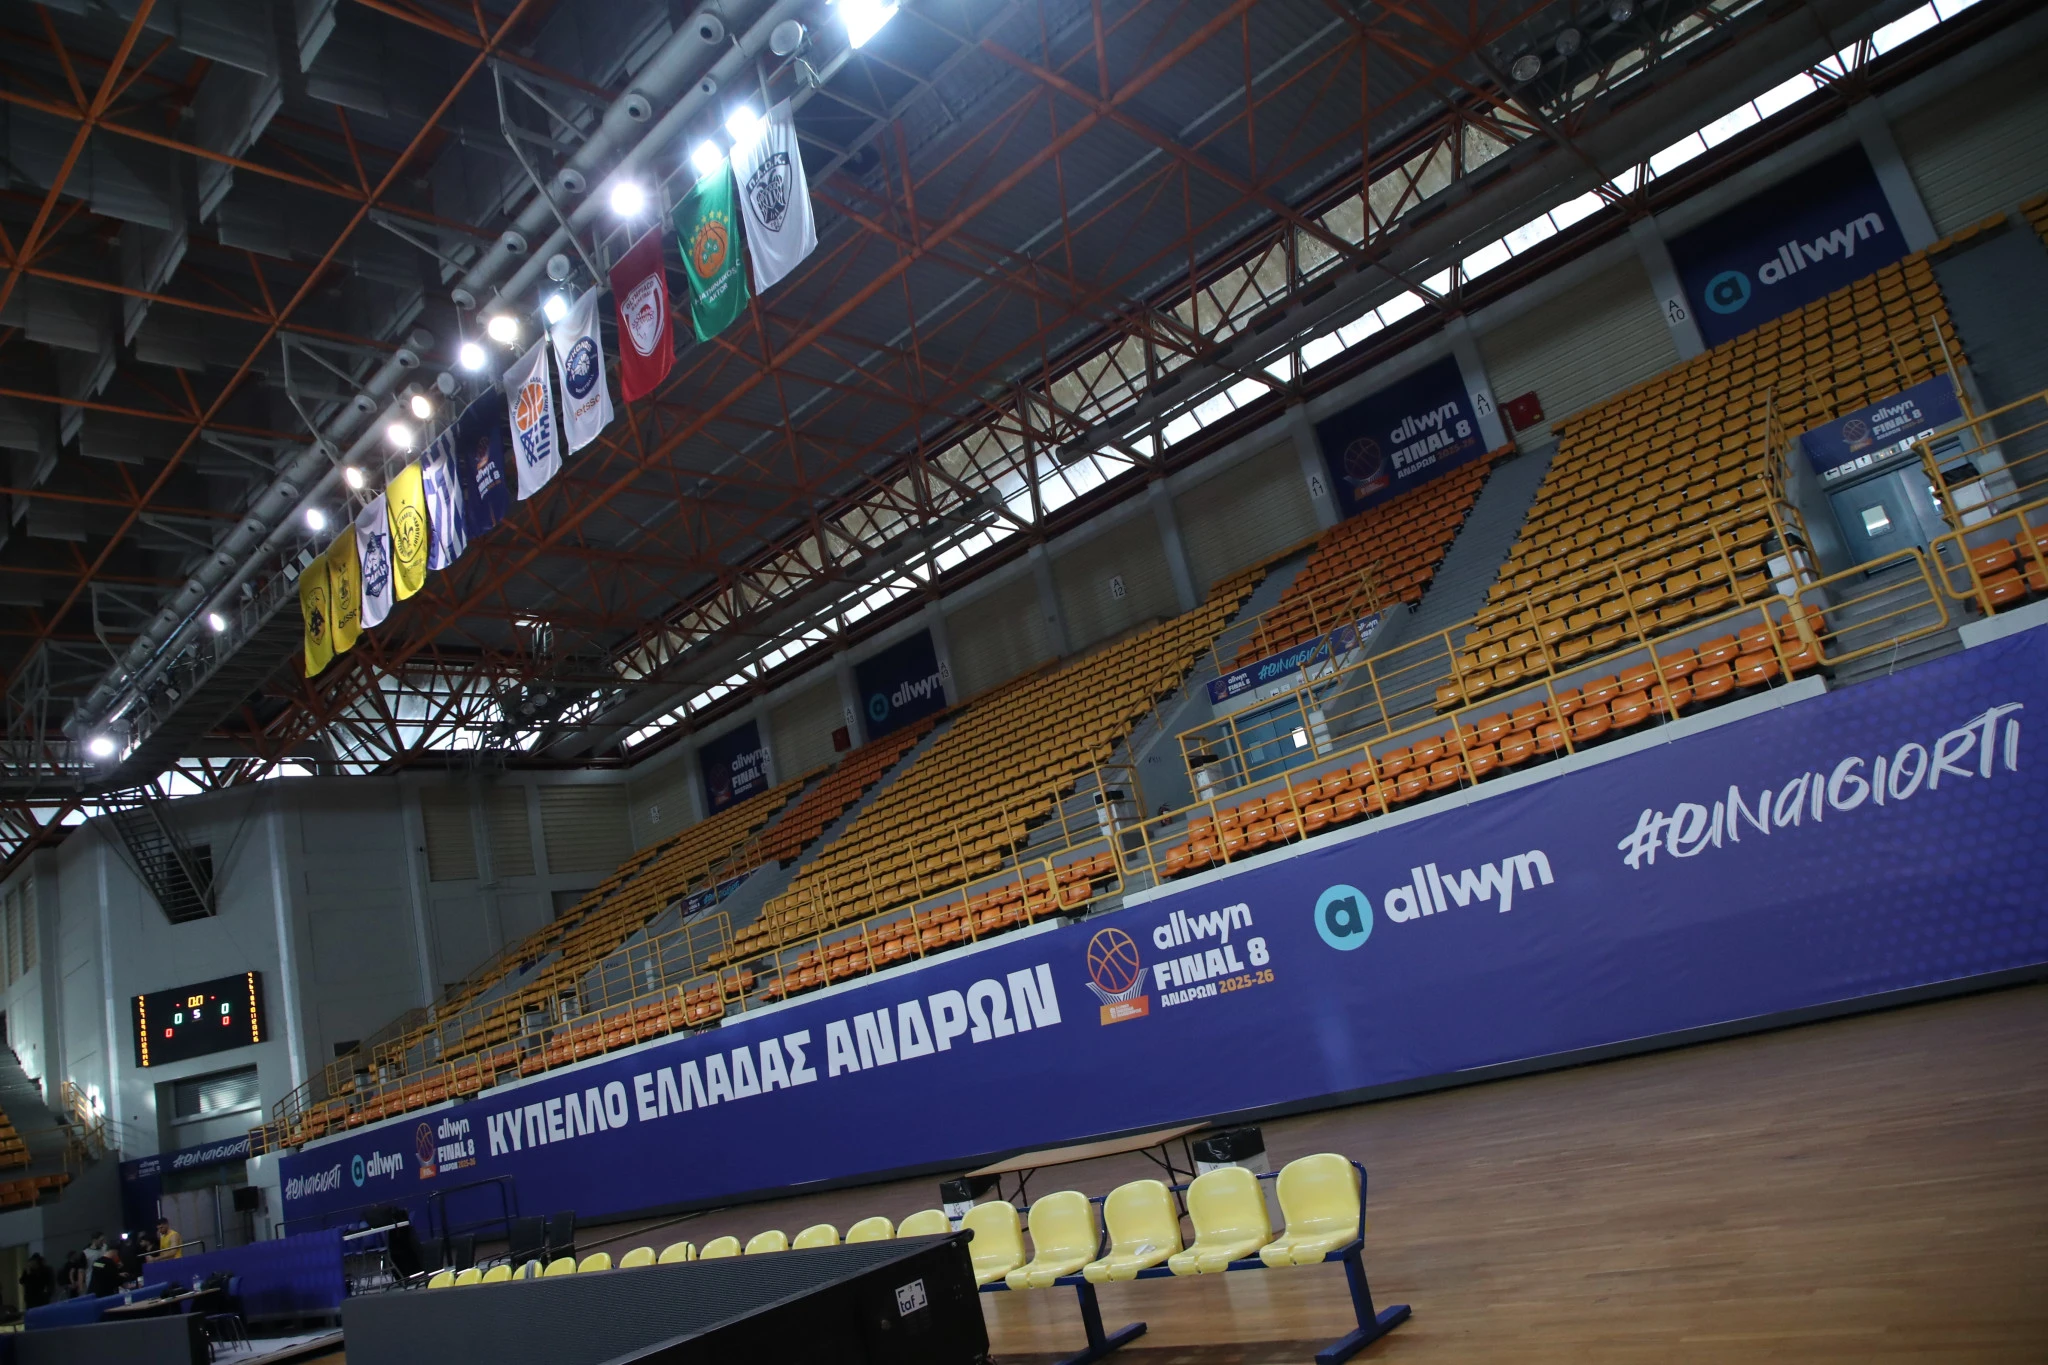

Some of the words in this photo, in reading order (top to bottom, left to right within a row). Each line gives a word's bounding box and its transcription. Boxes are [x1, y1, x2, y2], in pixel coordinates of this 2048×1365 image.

[1758, 211, 1885, 286] allwyn
[1669, 308, 1685, 323] 10
[1390, 401, 1459, 444] allwyn
[1871, 400, 1914, 423] allwyn
[1872, 414, 1913, 436] FINAL
[1912, 409, 1923, 419] 8
[1390, 428, 1455, 470] FINAL
[1455, 420, 1472, 438] 8
[891, 672, 943, 708] allwyn
[1228, 673, 1247, 684] allwyn
[732, 766, 760, 788] FINAL
[1384, 849, 1555, 924] allwyn
[1153, 902, 1253, 950] allwyn
[1152, 944, 1245, 991] FINAL
[1247, 936, 1270, 967] 8
[1161, 982, 1218, 1008] ΑΝΔΡΩΝ
[1218, 968, 1275, 994] 2025-26
[174, 1012, 183, 1025] 0
[193, 1009, 200, 1019] 5
[221, 1002, 230, 1015] 0
[222, 1015, 230, 1026] 0
[165, 1028, 173, 1038] 0
[486, 1080, 629, 1157] ΚΥΠΕΛΛΟ
[633, 1030, 818, 1122] ΕΛΛΑΔΑΣ
[825, 962, 1062, 1078] ΑΝΔΡΩΝ
[438, 1118, 470, 1140] allwyn
[437, 1141, 467, 1163] FINAL
[467, 1138, 475, 1156] 8
[367, 1151, 403, 1180] allwyn
[900, 1295, 915, 1313] taf
